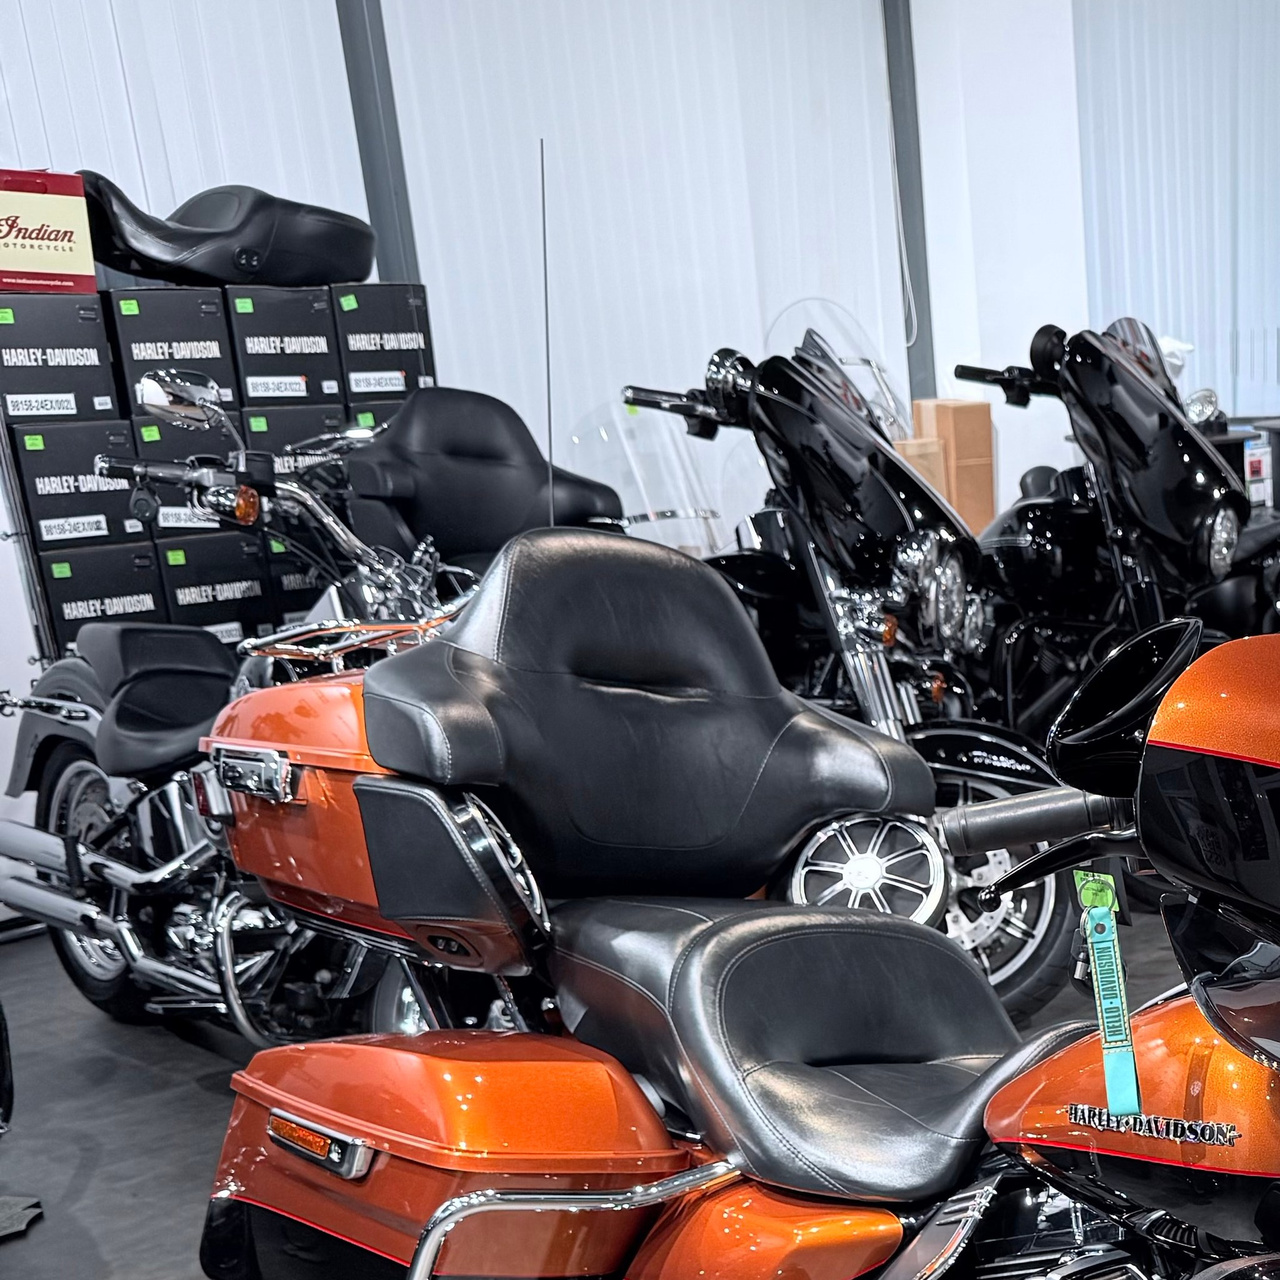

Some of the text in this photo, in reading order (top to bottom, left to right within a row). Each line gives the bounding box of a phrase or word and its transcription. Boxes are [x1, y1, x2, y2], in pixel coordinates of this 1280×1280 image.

[0, 215, 75, 243] Indian
[2, 242, 74, 252] OTORCYCLE
[131, 341, 221, 361] HARLEY-DAVIDSON
[245, 335, 329, 354] HARLEY-DAVIDSON
[347, 332, 425, 350] HARLEY-DAVIDSON
[2, 347, 99, 367] HARLEY-DAVIDSON
[175, 580, 263, 606] HARLEY-DAVIDSON
[62, 593, 156, 620] HARLEY-DAVIDSON
[1096, 946, 1124, 1037] HELLO DAVIDSON
